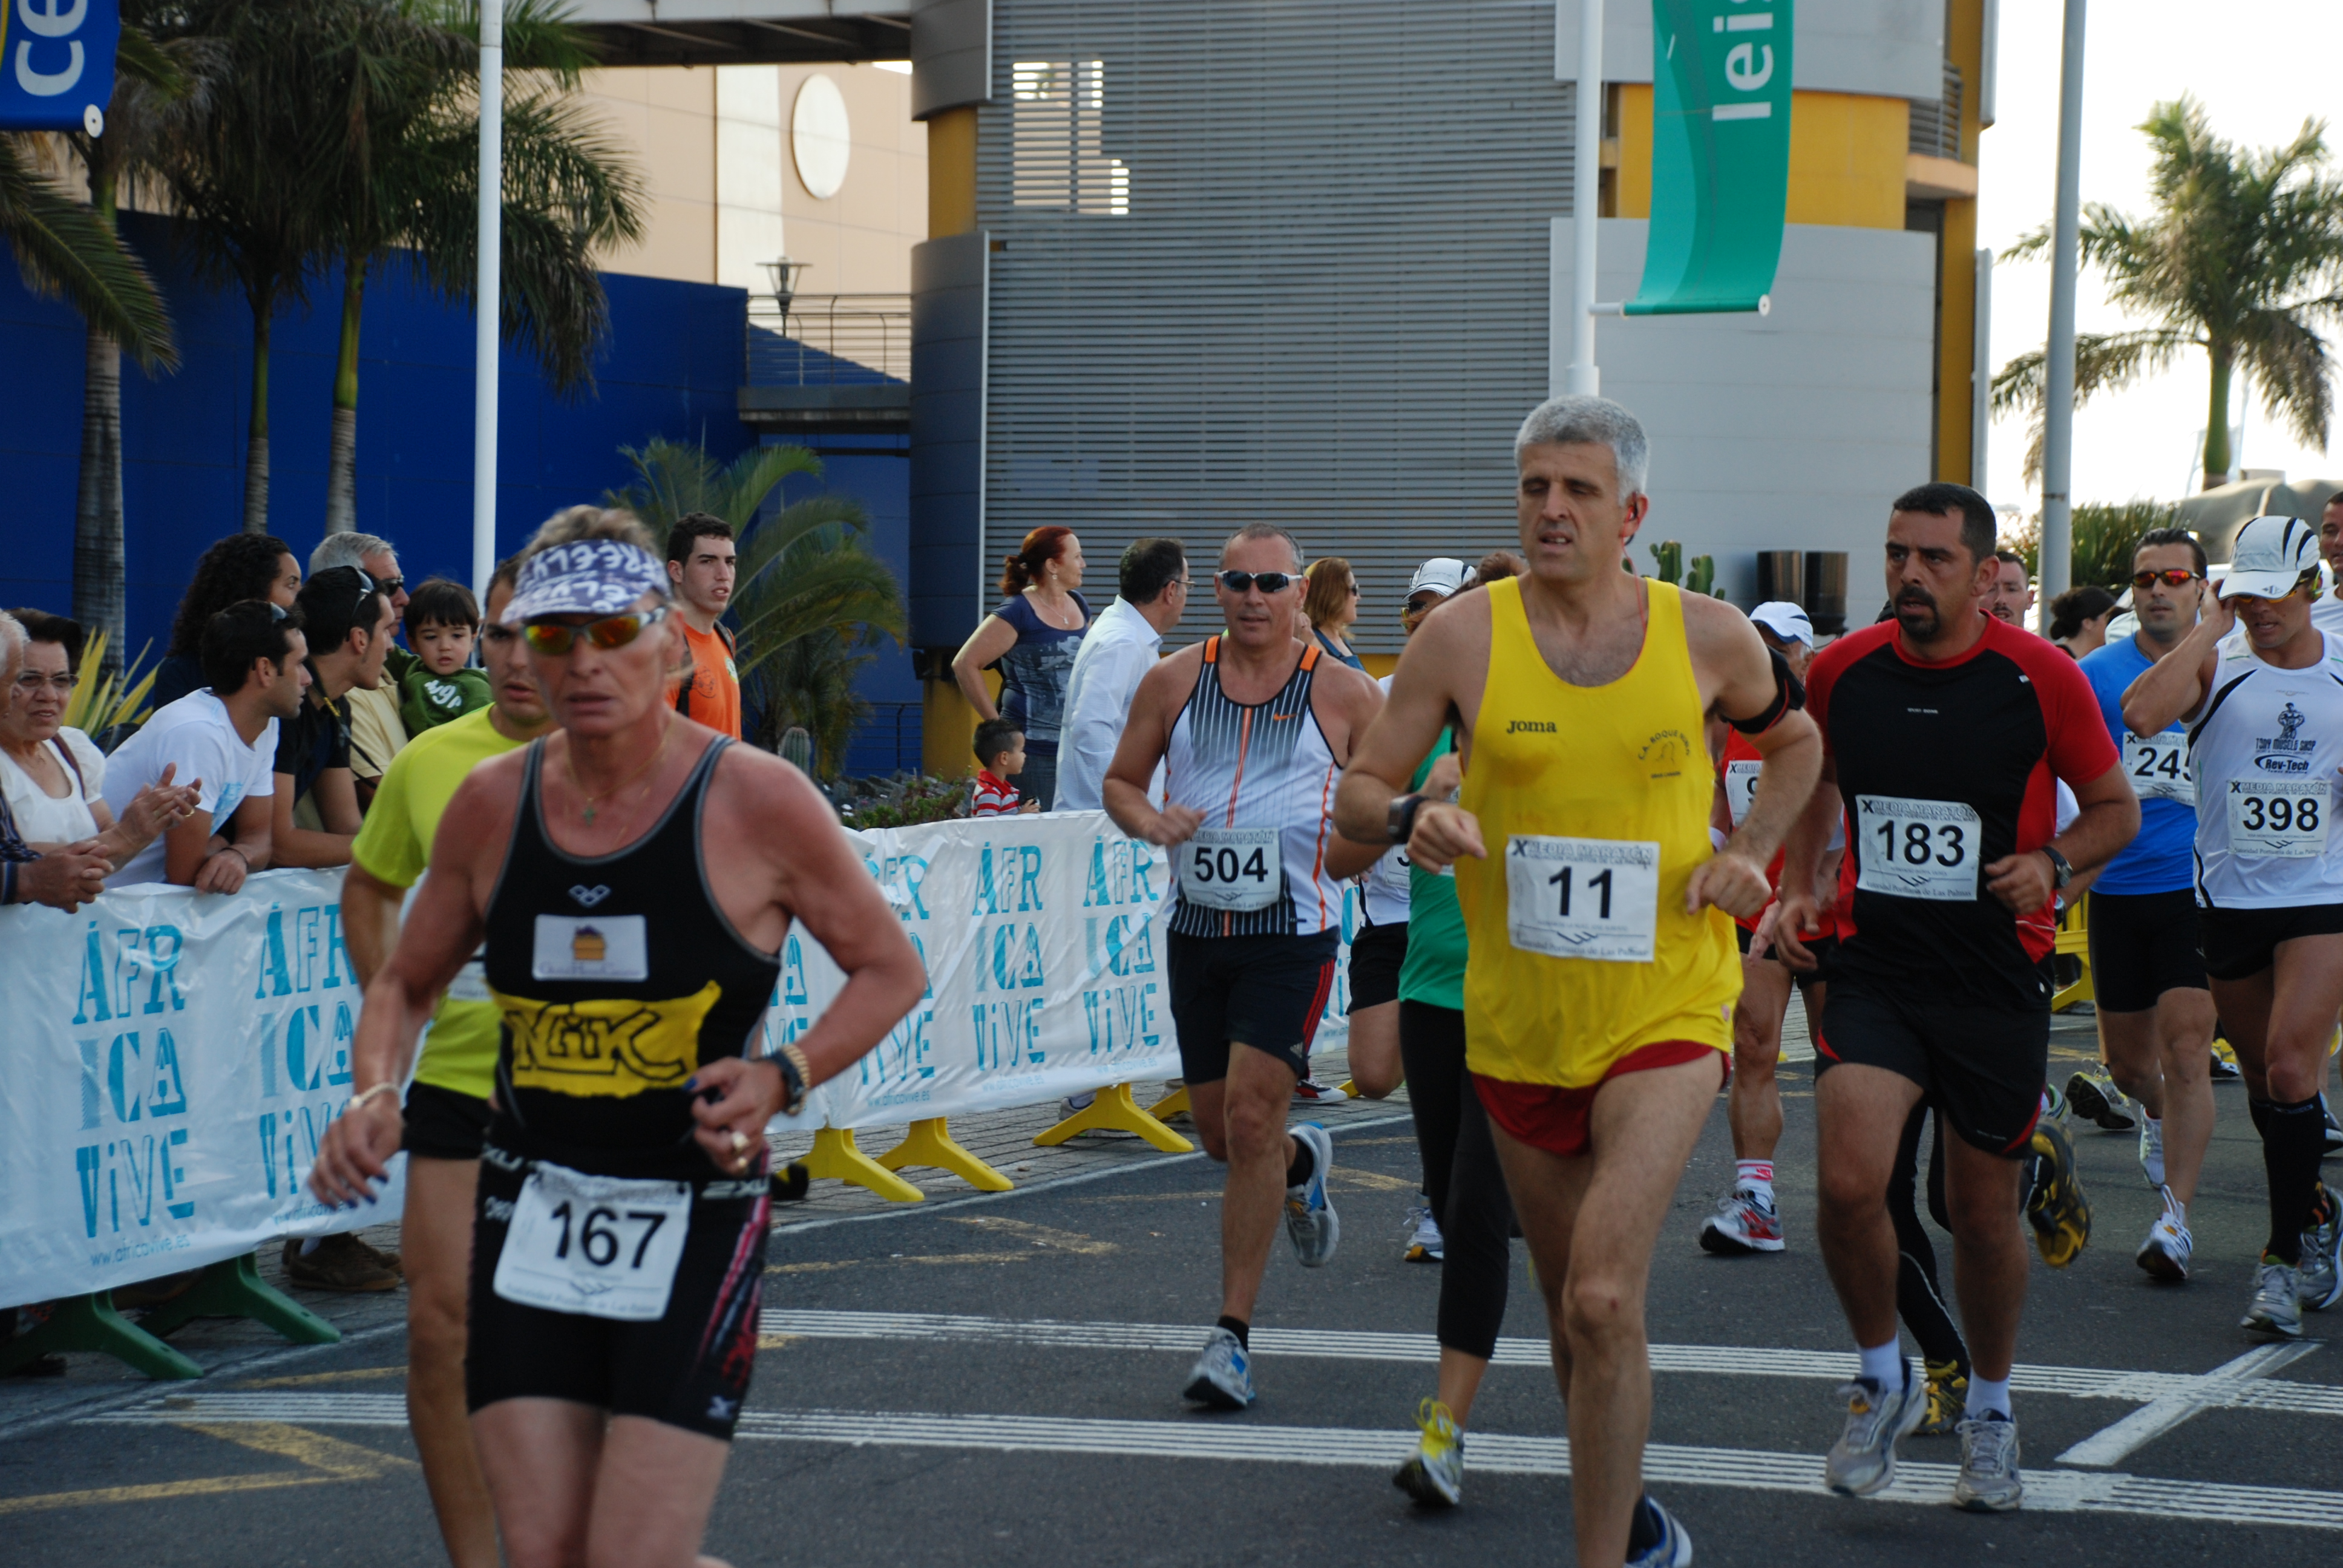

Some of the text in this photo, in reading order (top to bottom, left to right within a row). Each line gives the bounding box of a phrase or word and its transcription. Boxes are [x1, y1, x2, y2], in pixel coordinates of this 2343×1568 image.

[1712, 0, 1774, 121] lei
[2230, 782, 2241, 793] X
[2242, 782, 2274, 791] MEDIA
[2265, 759, 2309, 771] Rev-Tech
[1861, 799, 1874, 813] X
[1876, 801, 1910, 812] MEDIA
[2243, 797, 2319, 832] 398
[1194, 847, 1268, 883] 504
[1513, 839, 1653, 859] X MEDIA MARATÓN
[1878, 820, 1965, 867] 183
[972, 841, 1043, 916] ÁFR
[1083, 835, 1159, 907] ÁFR
[1549, 866, 1612, 919] 11
[72, 920, 185, 1025] ÁFR
[974, 923, 1044, 993] ICA
[1085, 913, 1156, 980] ICA
[1588, 945, 1597, 955] de
[1601, 946, 1615, 955] Las
[76, 1027, 187, 1131] ICA
[551, 1200, 667, 1269] 167
